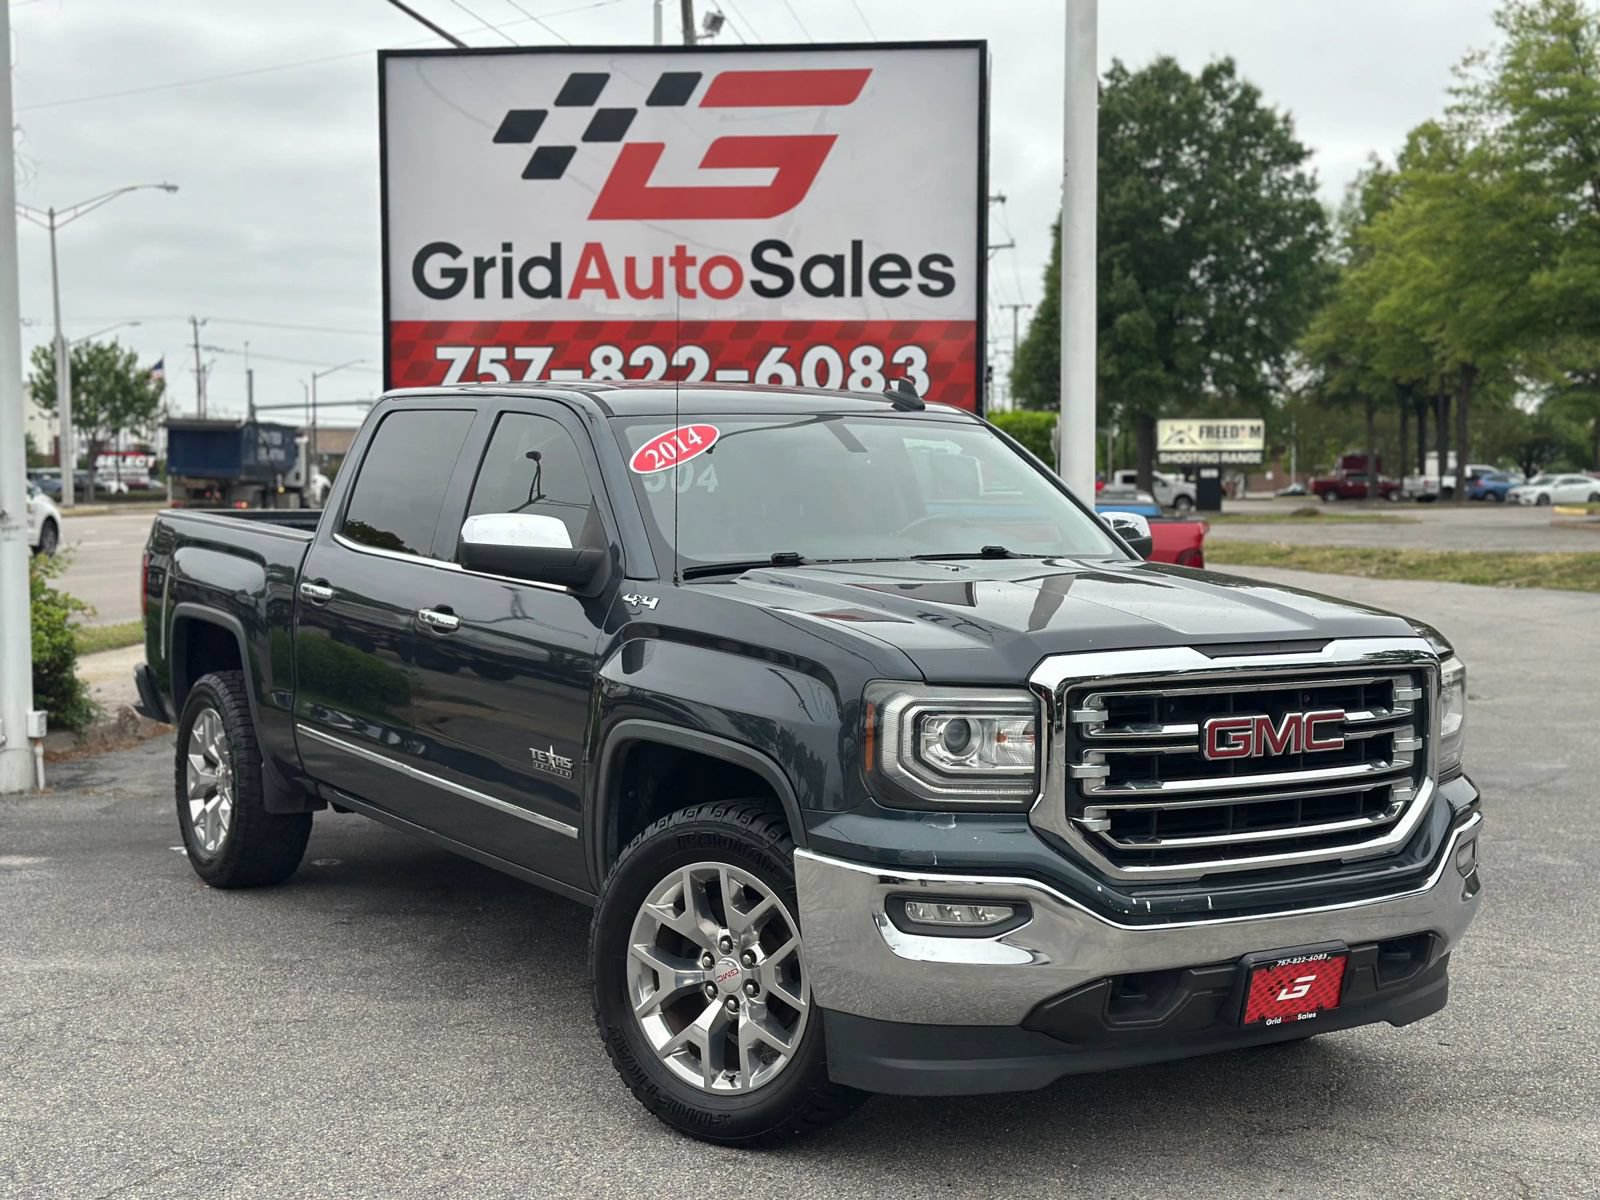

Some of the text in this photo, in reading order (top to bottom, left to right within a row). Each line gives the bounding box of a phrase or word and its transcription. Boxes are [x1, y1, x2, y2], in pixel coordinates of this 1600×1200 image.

[435, 345, 930, 397] 757-822-6083
[645, 427, 703, 469] 2014
[1204, 709, 1345, 760] GMC
[716, 968, 739, 983] GMC
